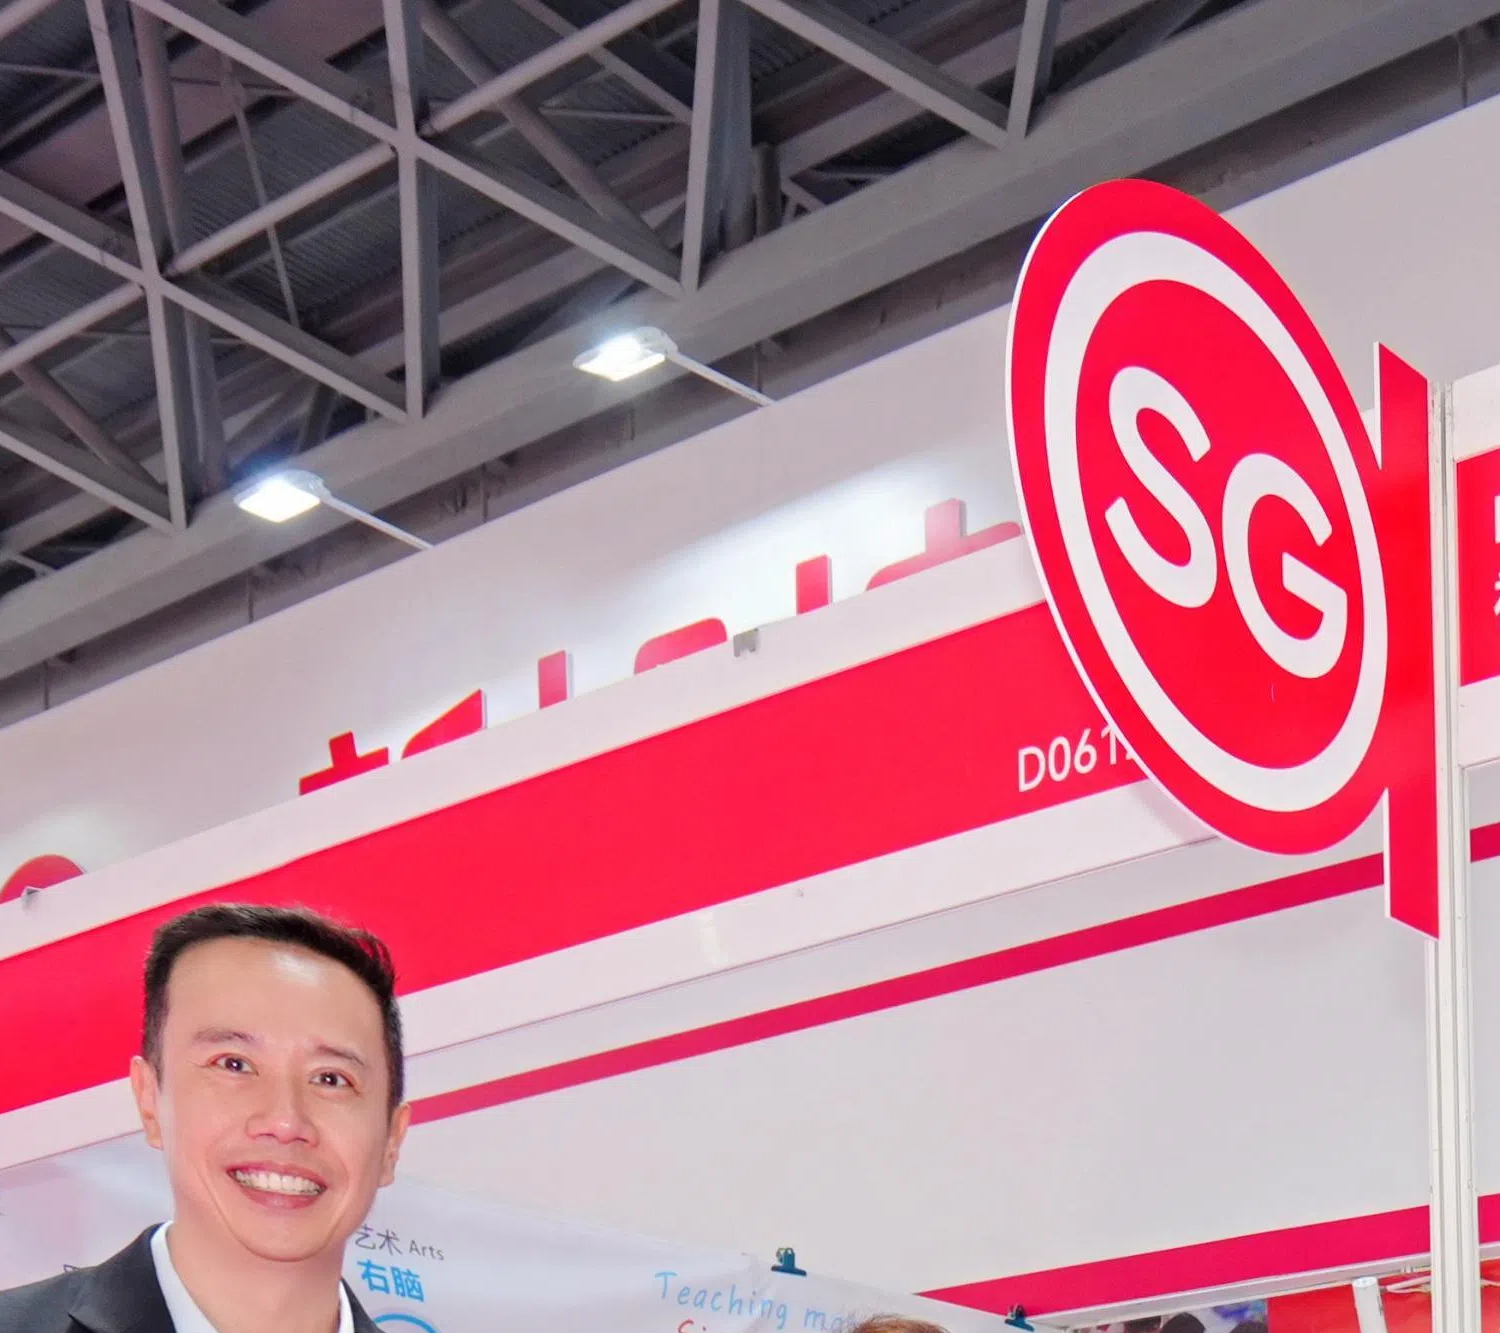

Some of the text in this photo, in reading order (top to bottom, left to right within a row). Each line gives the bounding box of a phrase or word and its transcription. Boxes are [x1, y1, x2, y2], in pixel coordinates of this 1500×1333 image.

[1103, 363, 1350, 679] SG
[1017, 723, 1136, 793] D061
[356, 1259, 425, 1303] 右脑
[409, 1240, 445, 1261] Arts
[653, 1270, 789, 1331] Teaching
